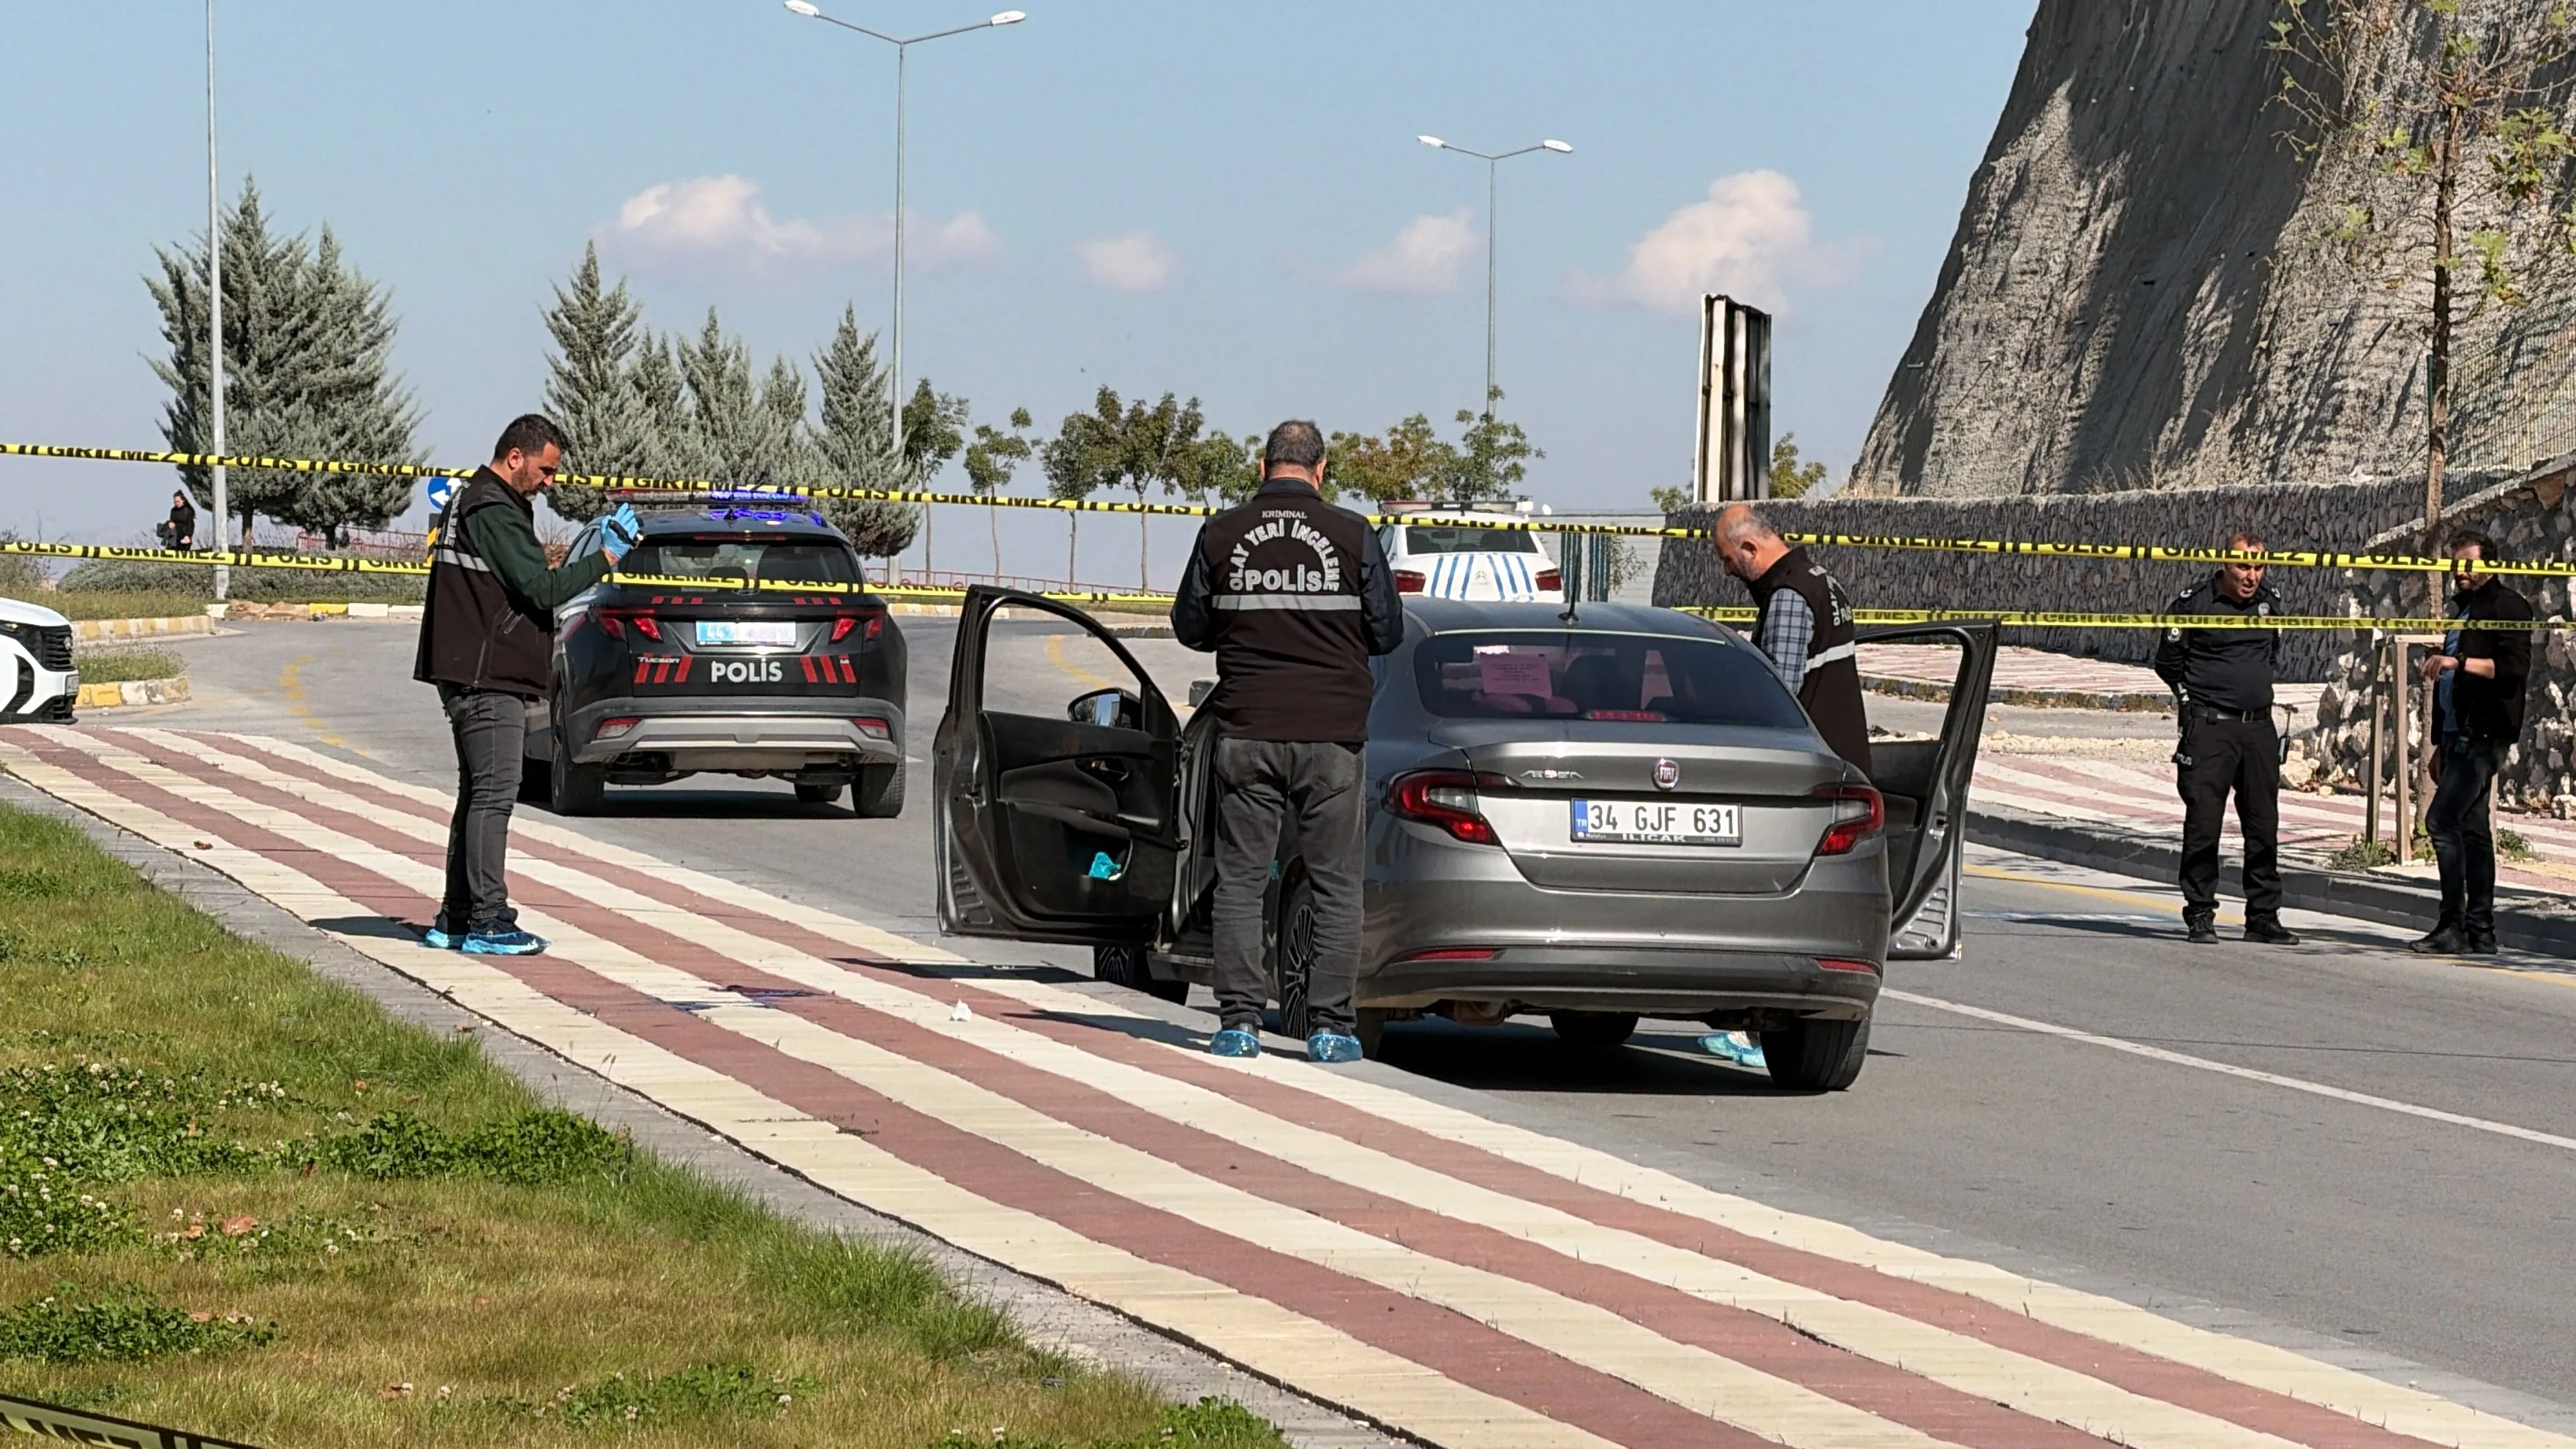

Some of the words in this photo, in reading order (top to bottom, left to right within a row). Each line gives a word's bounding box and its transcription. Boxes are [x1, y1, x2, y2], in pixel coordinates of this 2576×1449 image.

[1229, 543, 1250, 591] OLAY
[1244, 518, 1285, 546] YERİ
[1291, 520, 1341, 592] İNCELEME
[1245, 564, 1322, 592] POLİS
[711, 656, 782, 683] POLİS
[1660, 765, 1674, 780] FIAT
[1576, 818, 1587, 827] TR
[1590, 805, 1618, 831] 34
[1635, 806, 1677, 832] GJF
[1693, 808, 1734, 834] 631
